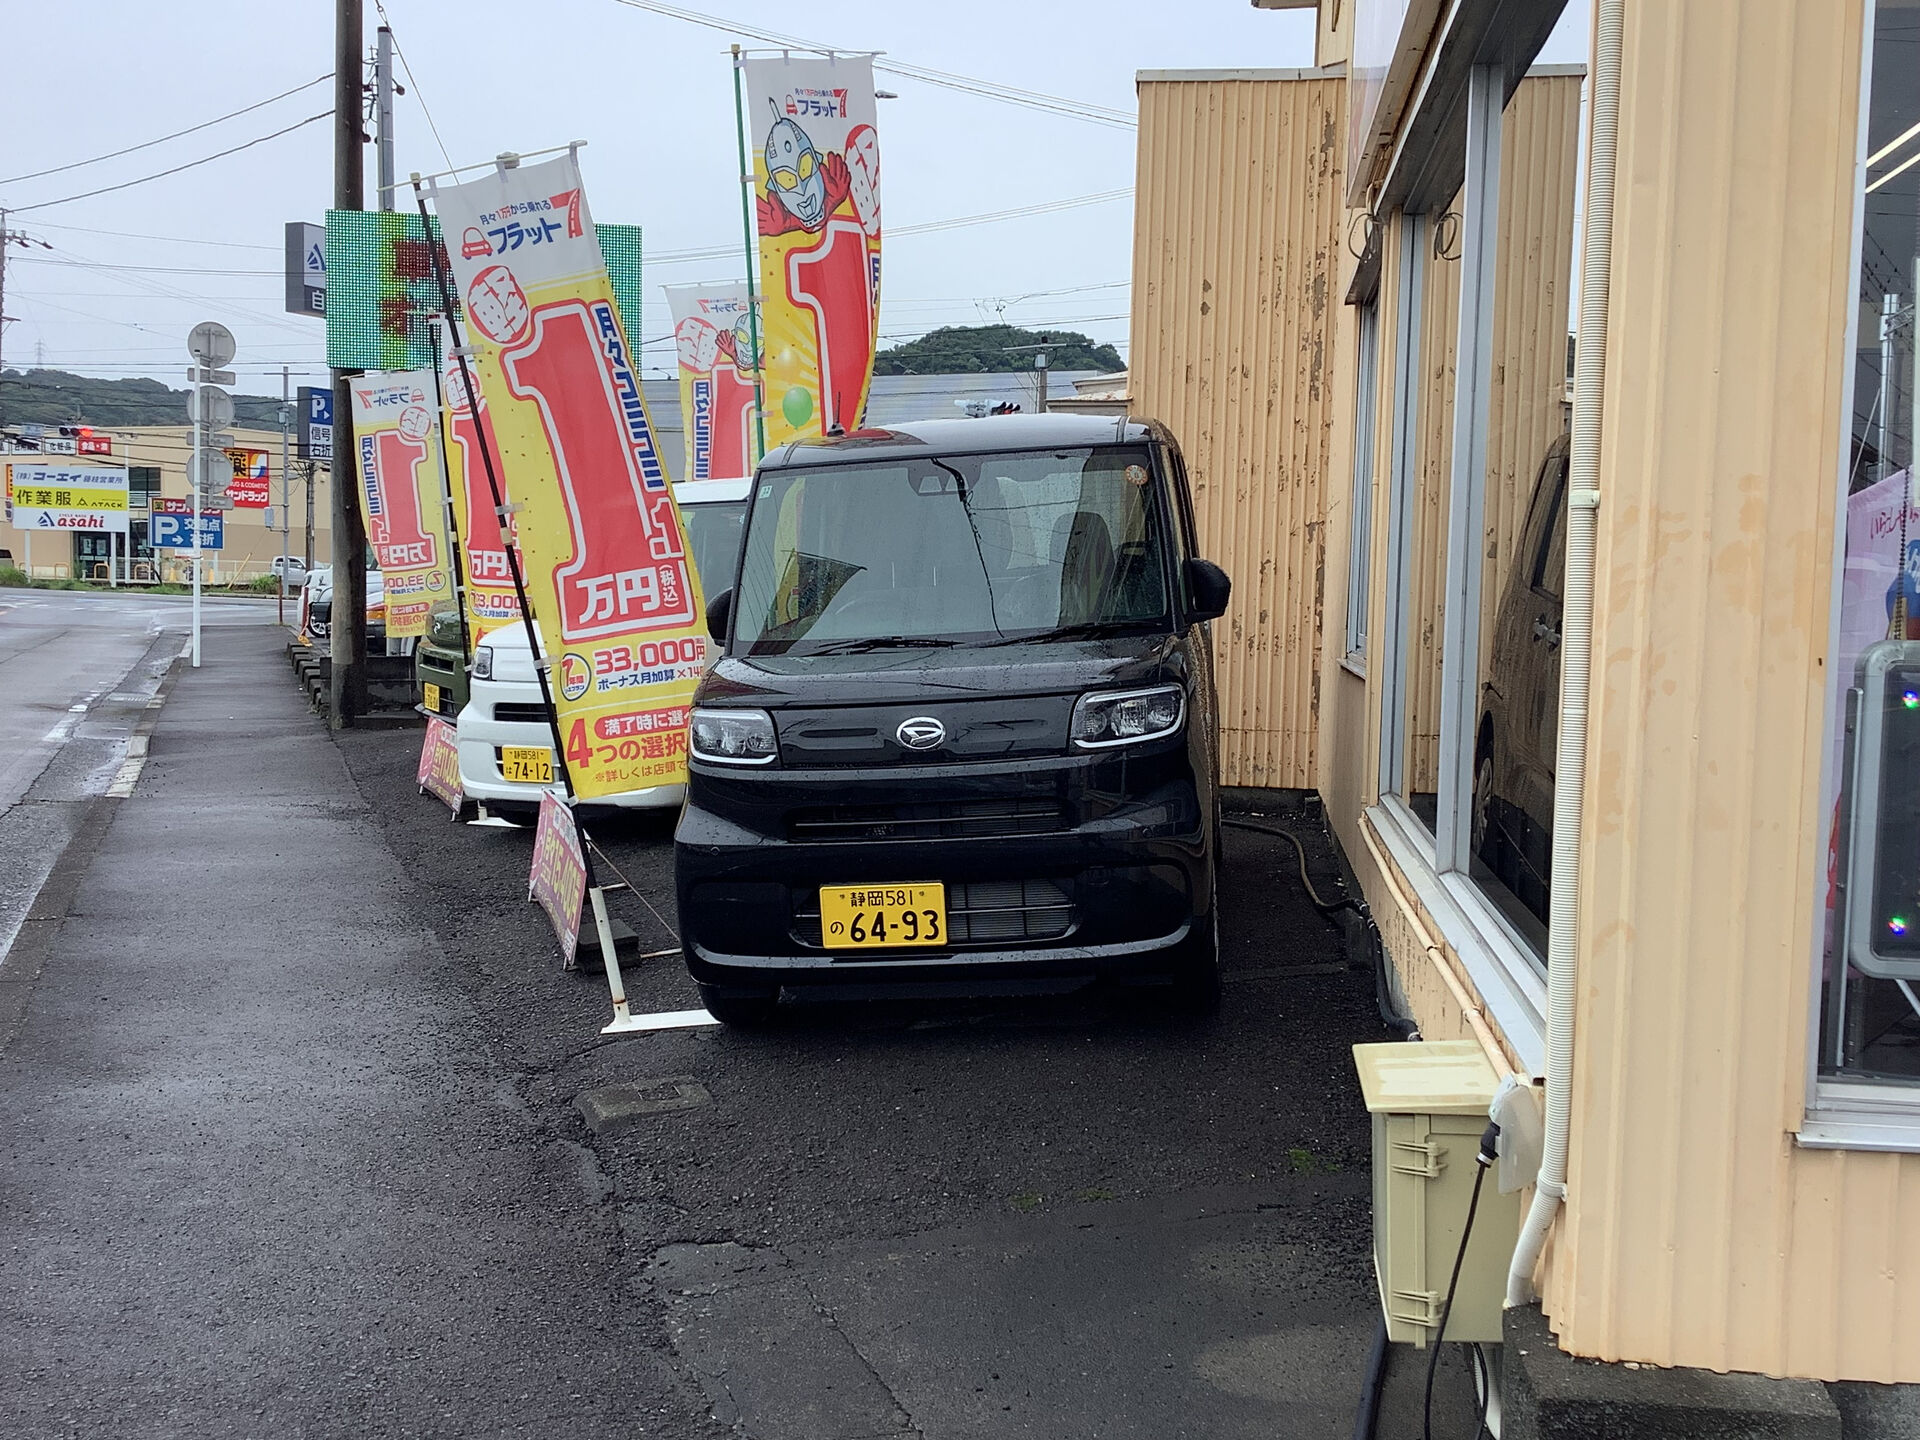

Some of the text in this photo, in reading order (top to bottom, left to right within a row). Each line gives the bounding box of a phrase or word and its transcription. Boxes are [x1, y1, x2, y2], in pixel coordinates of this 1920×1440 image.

[797, 100, 837, 118] フラット
[488, 217, 562, 254] フラット
[311, 394, 326, 418] P
[595, 307, 665, 488] 月々コミコミ
[311, 427, 331, 441] 信号
[311, 443, 331, 457] 右折
[33, 472, 81, 482] コーエイ
[17, 489, 71, 506] 作業服
[225, 489, 268, 502] サンドラッグ
[57, 515, 104, 528] asahi
[155, 516, 179, 544] P
[576, 567, 661, 626] 万円
[567, 718, 593, 769] 4
[513, 762, 550, 780] 74-12
[850, 890, 913, 907] 静岡581
[830, 910, 939, 943] の 64-93
